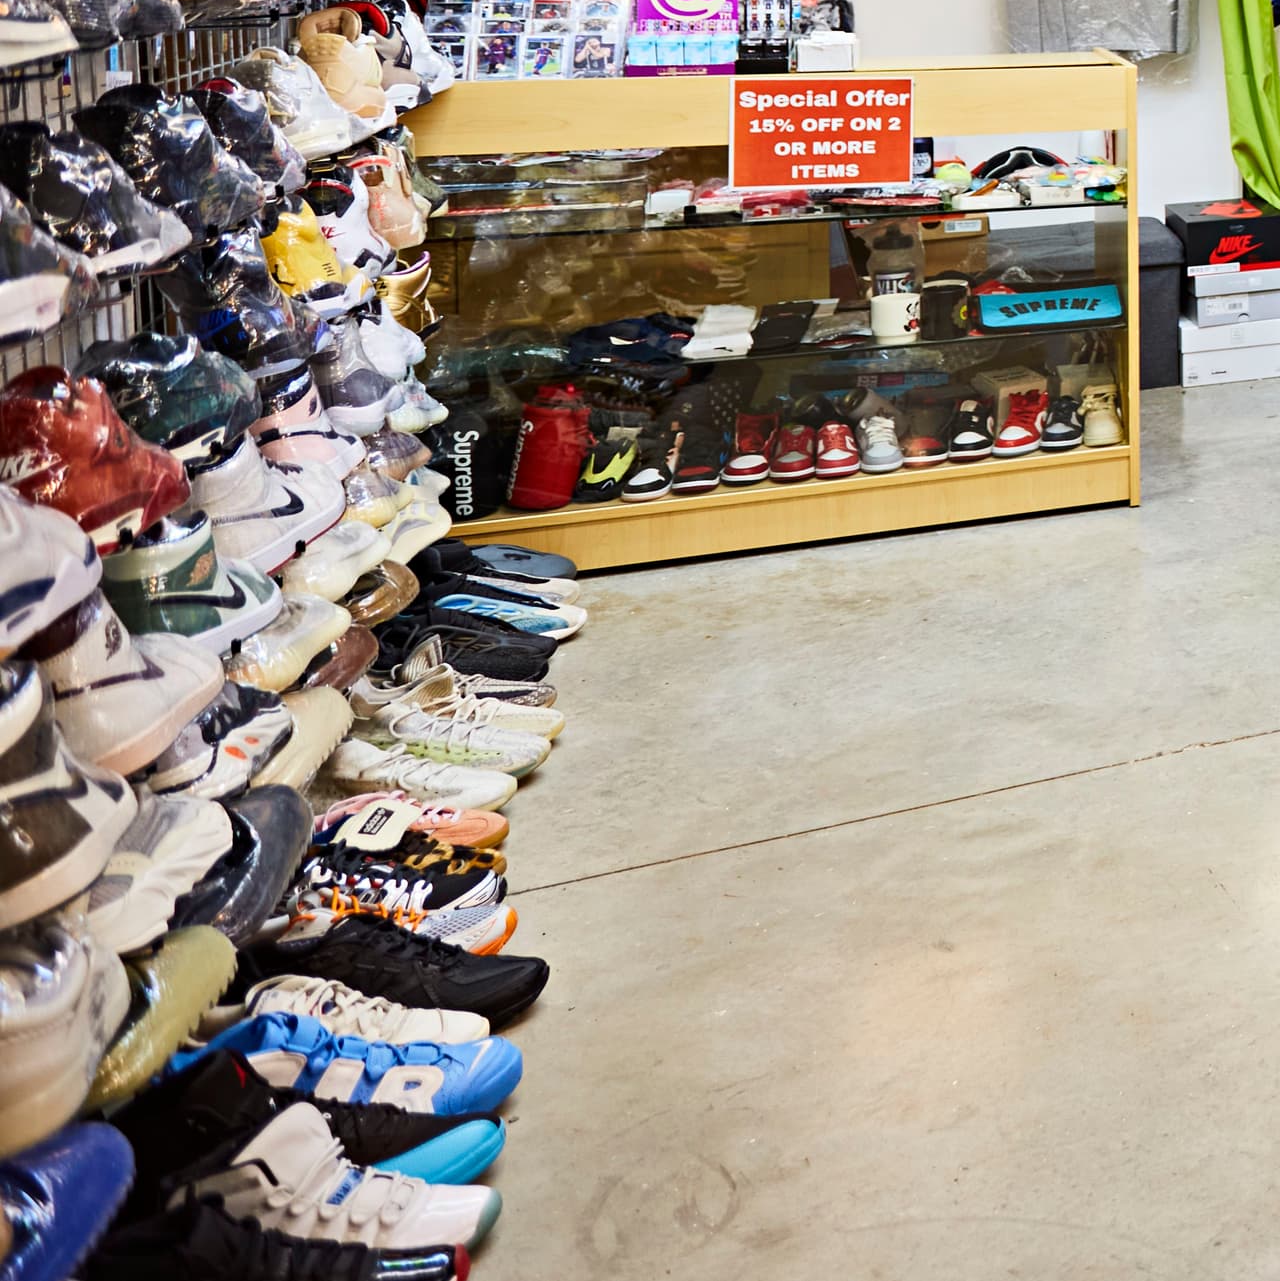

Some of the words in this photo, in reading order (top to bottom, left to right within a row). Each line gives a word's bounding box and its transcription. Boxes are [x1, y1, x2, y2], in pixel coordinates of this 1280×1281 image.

[739, 90, 837, 111] Special
[846, 89, 910, 107] Offer
[749, 118, 795, 133] 15%
[801, 117, 844, 132] OFF
[850, 117, 882, 131] ON
[888, 117, 901, 131] 2
[774, 141, 806, 156] OR
[812, 140, 876, 154] MORE
[792, 164, 859, 179] ITEMS
[1217, 234, 1255, 253] NIKE
[998, 297, 1101, 319] SUPREME
[447, 430, 480, 516] Supreme
